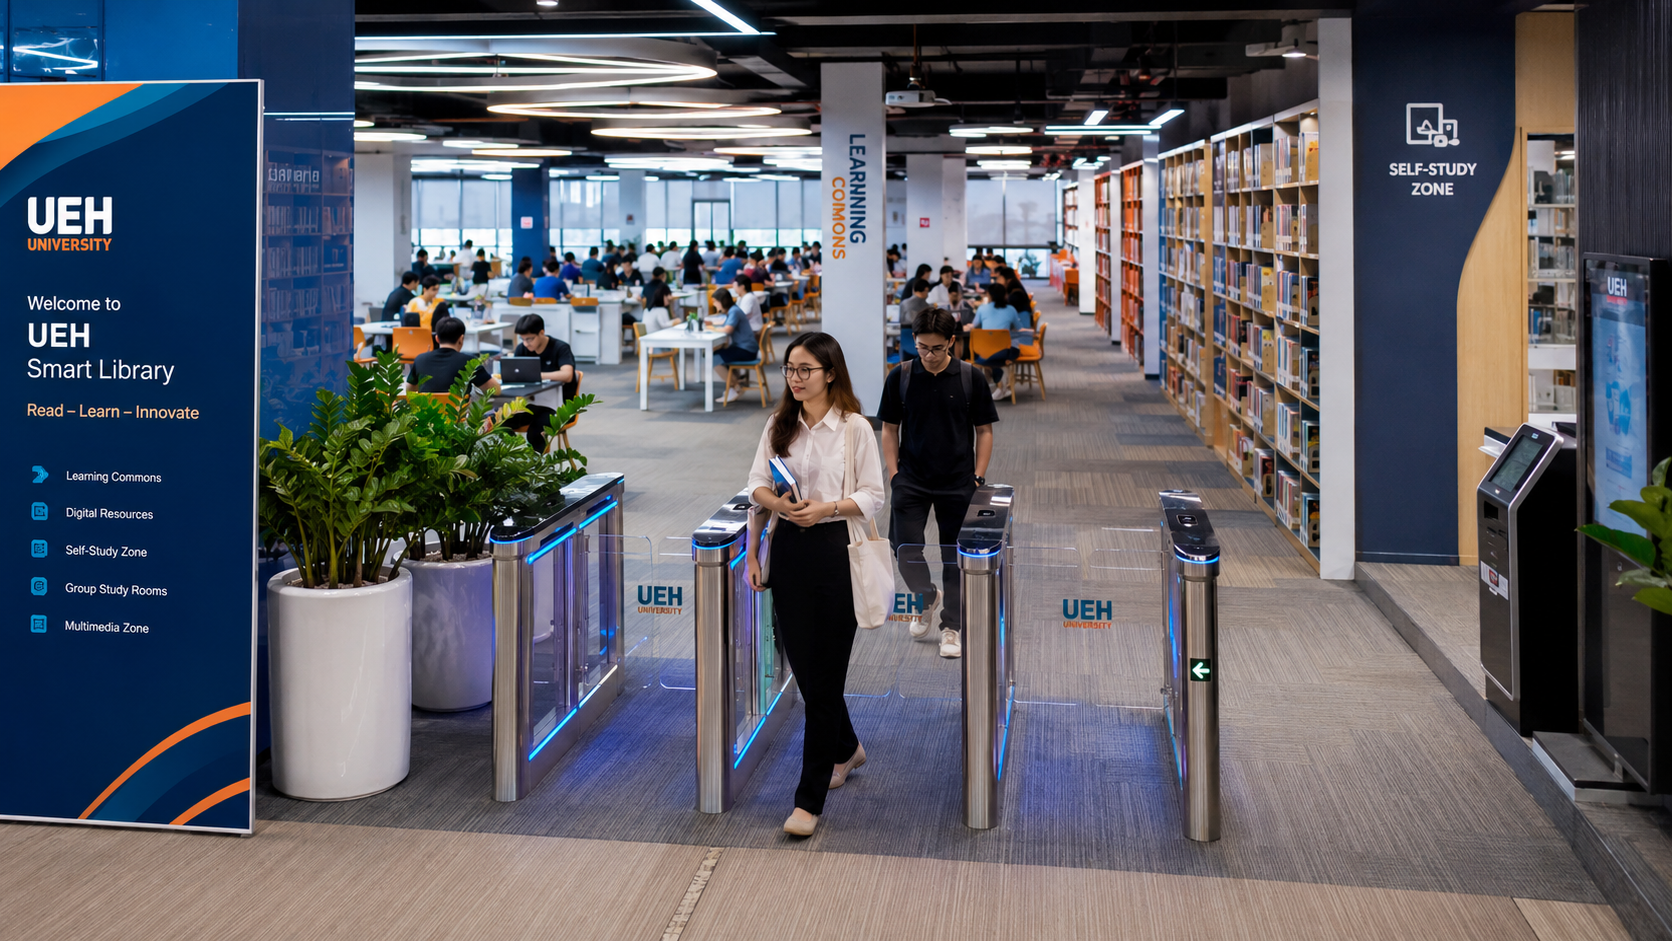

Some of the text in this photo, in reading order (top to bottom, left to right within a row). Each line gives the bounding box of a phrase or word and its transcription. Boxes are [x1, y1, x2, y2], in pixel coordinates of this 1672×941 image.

[1389, 162, 1478, 177] SELF-STUDY
[1411, 181, 1455, 196] ZONE
[27, 196, 113, 235] UEH
[27, 237, 113, 252] UNIVERSITY
[1607, 276, 1627, 297] UEH
[27, 295, 122, 312] Welcome to
[28, 322, 90, 348] UEH
[27, 357, 175, 386] Smart Library
[26, 403, 64, 418] Read
[79, 404, 121, 419] Learn
[136, 405, 200, 420] Innovate
[66, 470, 162, 485] Learning Commons
[66, 507, 154, 521] Digital Resources
[65, 544, 148, 559] Self-Study Zone
[65, 582, 168, 598] Group Study Rooms
[637, 584, 683, 606] UEH
[1062, 598, 1112, 621] UEH
[65, 619, 150, 634] Multimedia Zone
